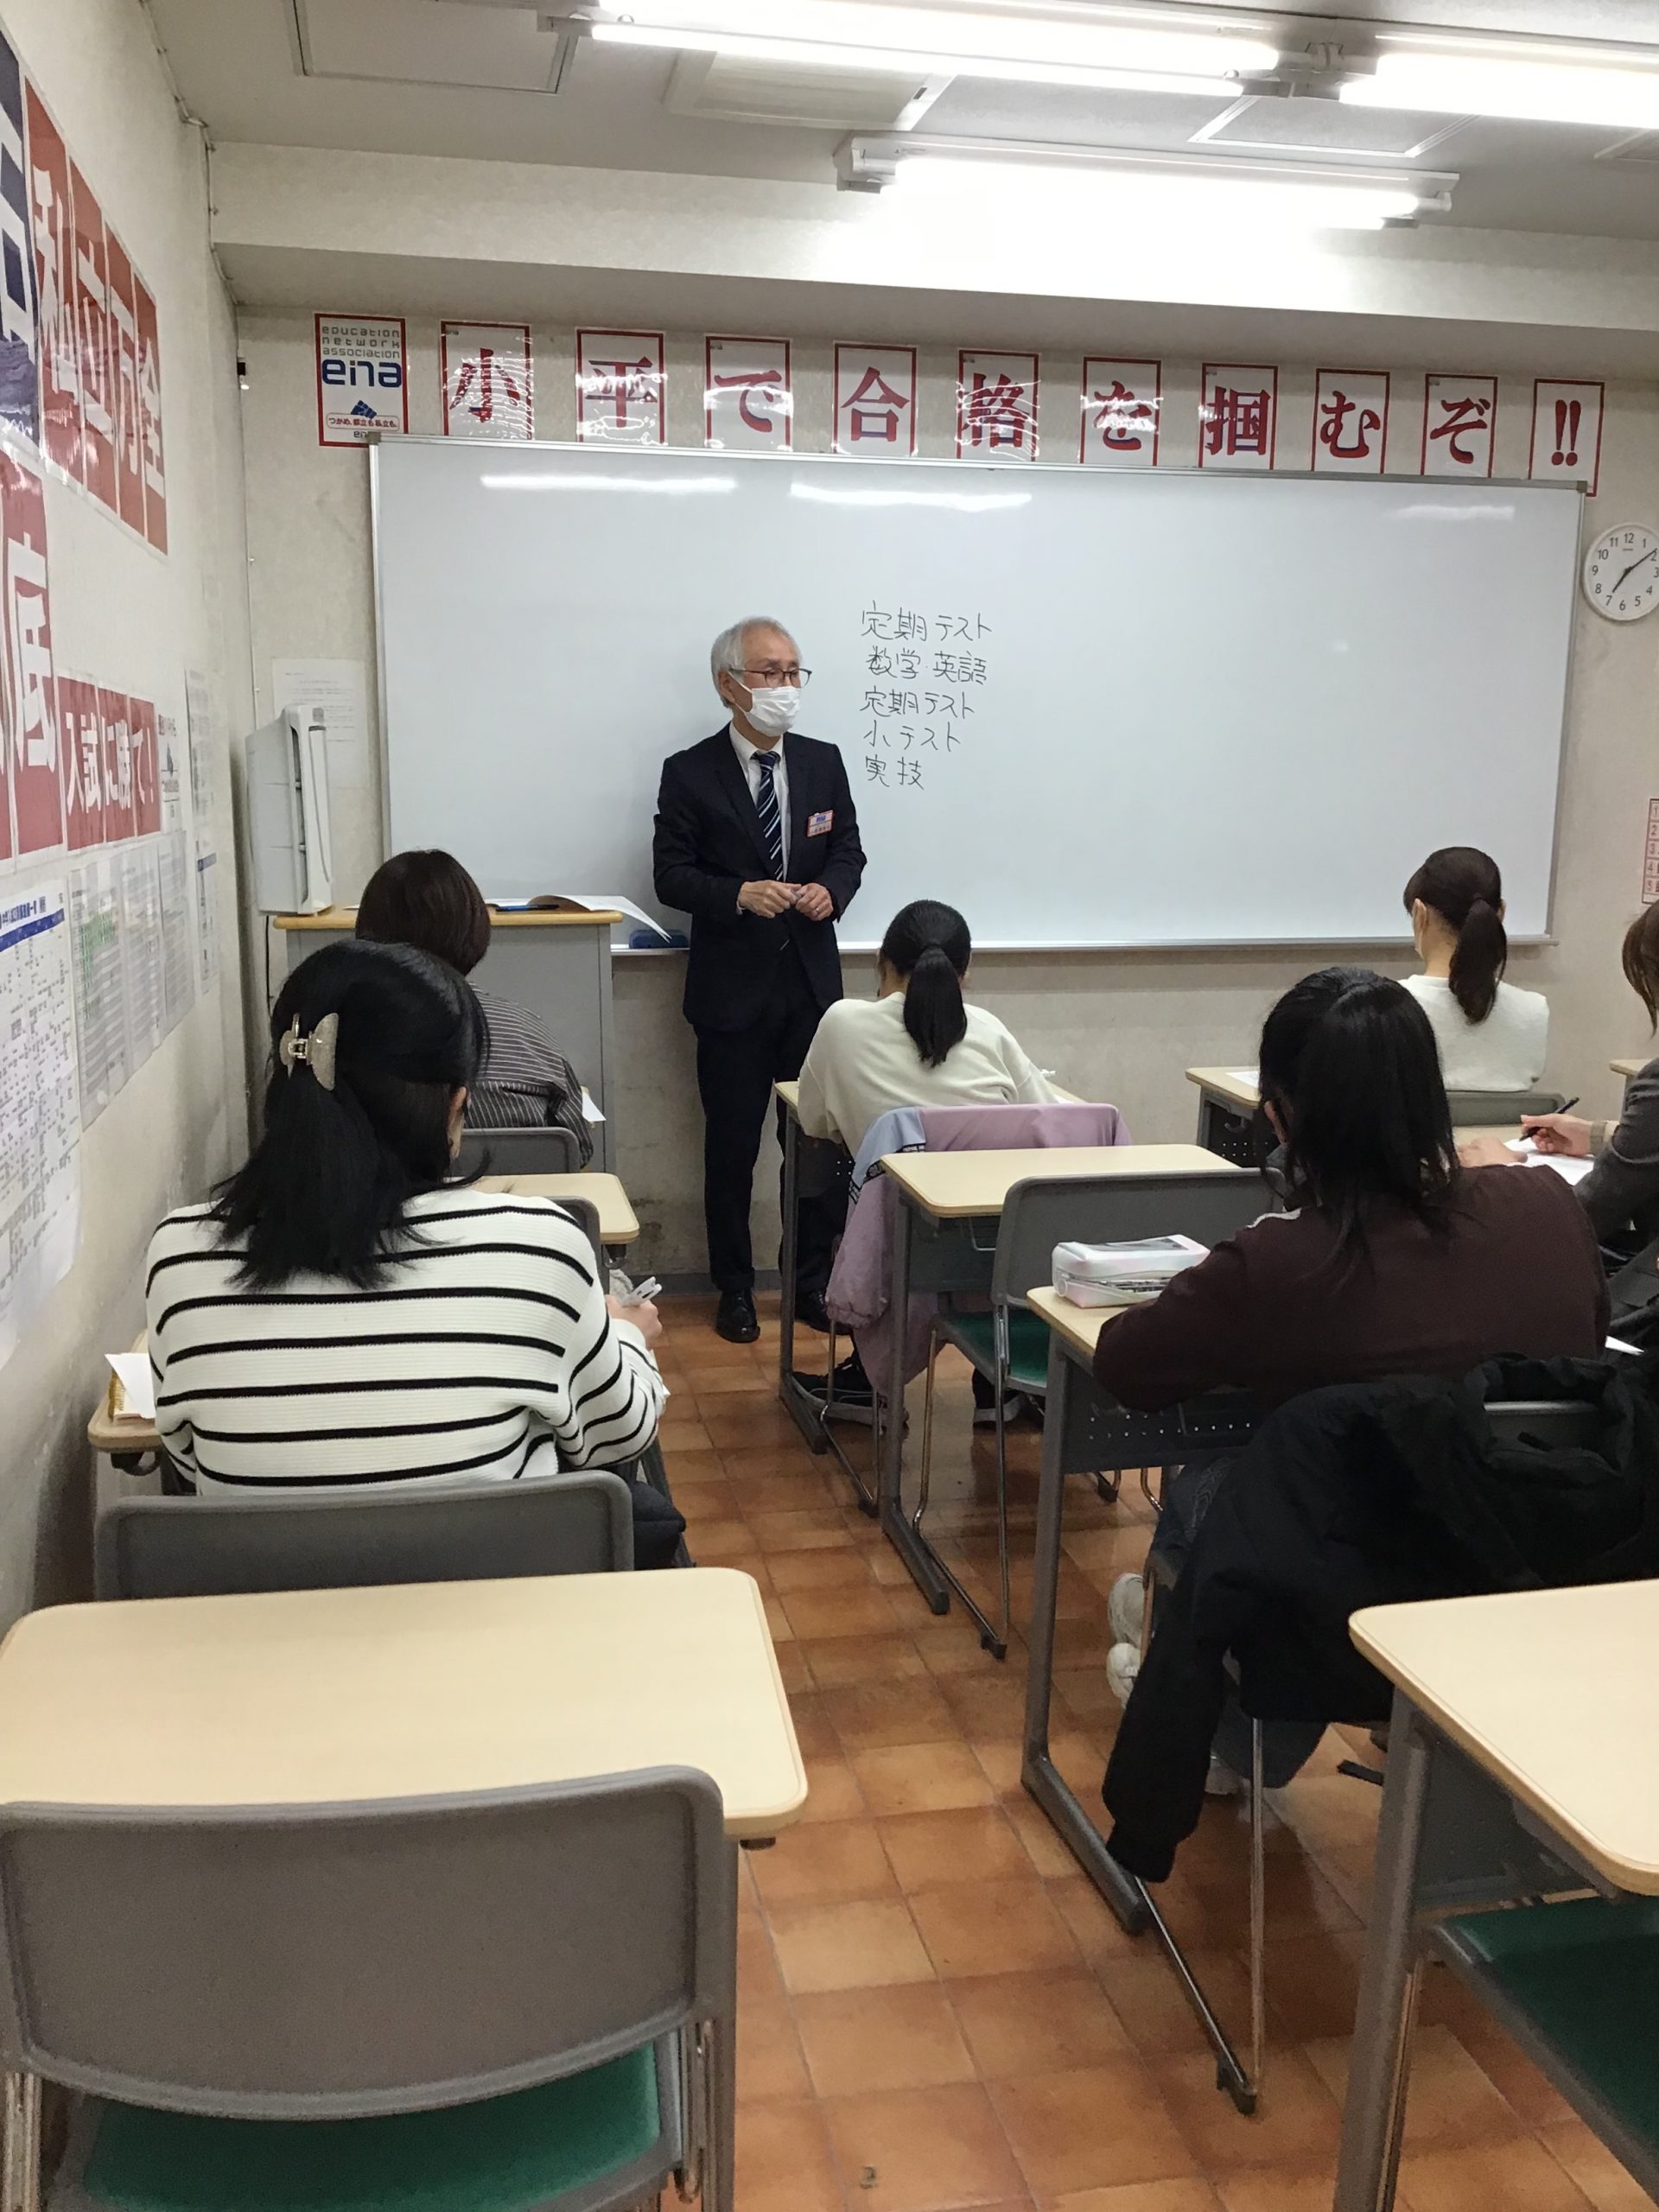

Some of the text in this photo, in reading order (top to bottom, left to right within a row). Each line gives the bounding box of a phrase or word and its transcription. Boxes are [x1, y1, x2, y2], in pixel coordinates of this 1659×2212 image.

[33, 163, 166, 499] 私立万全
[321, 325, 400, 338] education
[321, 336, 400, 348] network
[322, 346, 400, 359] association
[321, 359, 402, 388] ena
[1609, 537, 1619, 548] 11
[1624, 532, 1635, 544] 12
[1642, 538, 1647, 549] 1
[1597, 549, 1609, 560] 10
[1650, 550, 1657, 562] 2
[1592, 565, 1599, 575] 9
[1594, 583, 1602, 594] 8
[1645, 585, 1653, 595] 4
[1605, 594, 1612, 607] 7
[1618, 600, 1626, 611] 6
[1634, 595, 1641, 607] 5
[0, 531, 56, 773] 底
[859, 684, 976, 719] 定期テスト
[65, 711, 155, 817] 入試に勝て!
[864, 753, 925, 791] 実技
